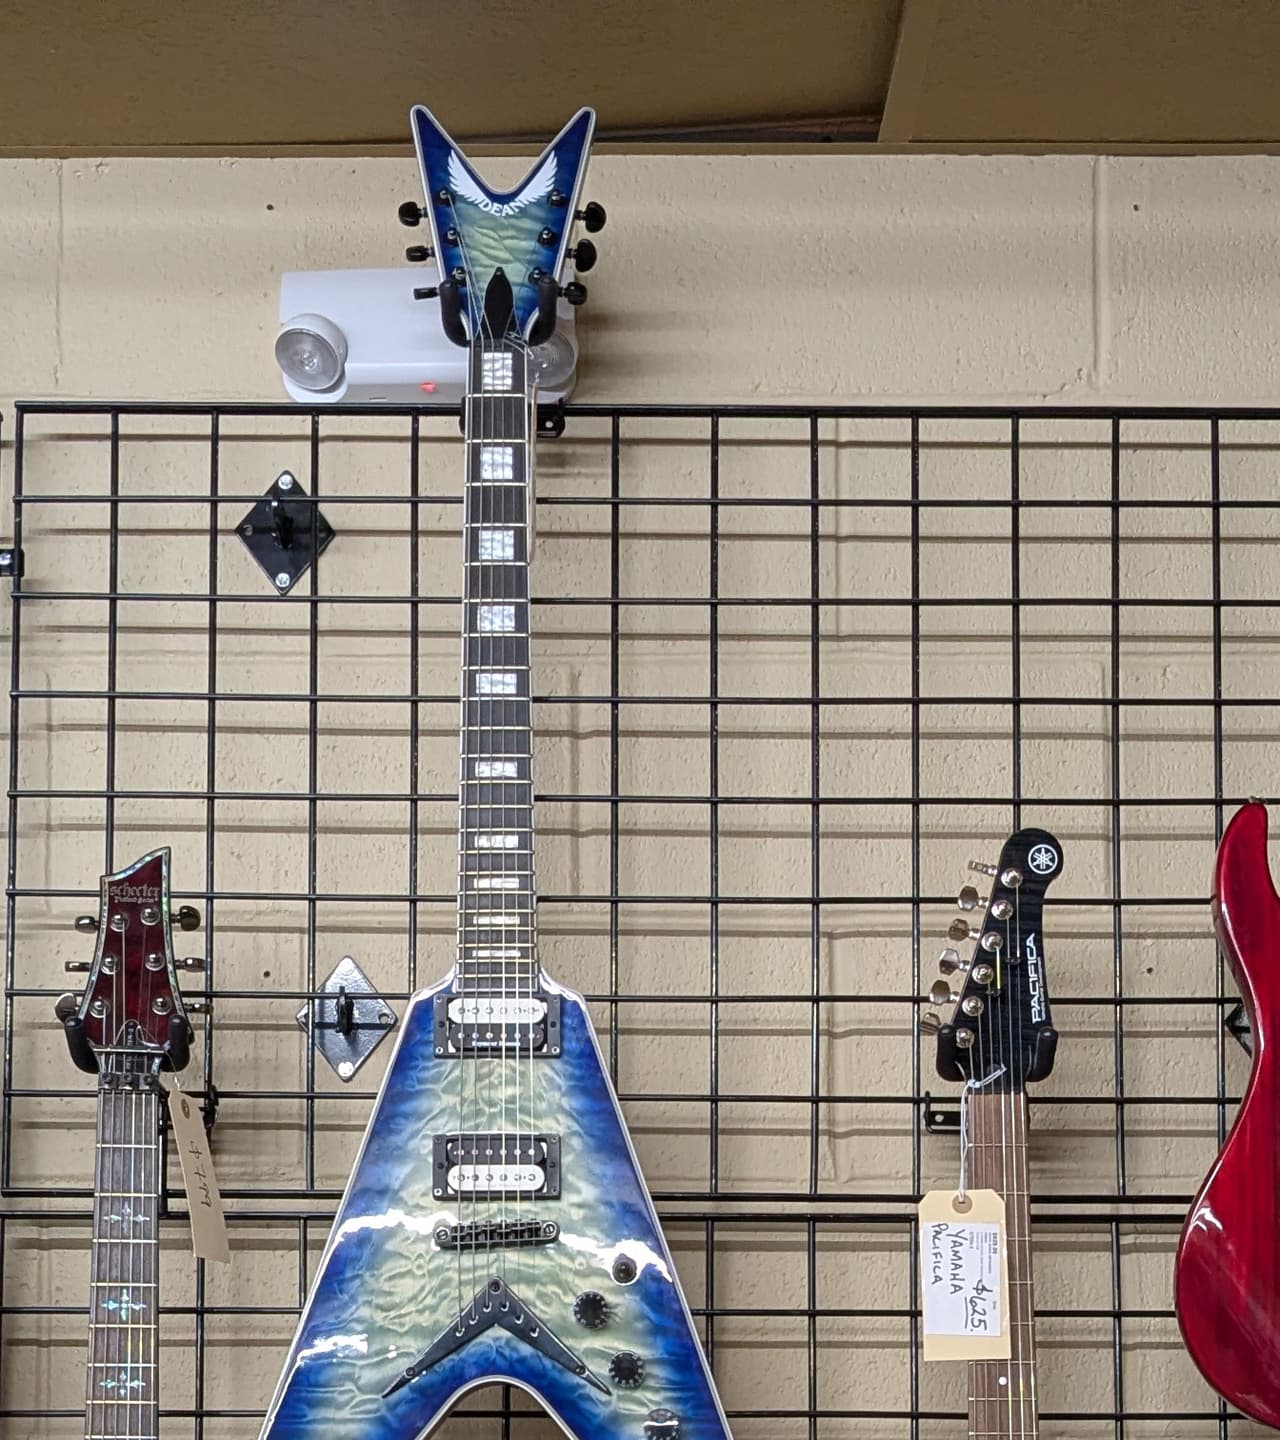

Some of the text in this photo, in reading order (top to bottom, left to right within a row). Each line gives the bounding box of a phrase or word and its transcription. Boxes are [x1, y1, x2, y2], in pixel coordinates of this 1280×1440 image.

[479, 199, 527, 217] DEAN
[1031, 932, 1040, 1025] PACIFICA
[931, 1223, 949, 1285] PACIFICA
[946, 1229, 969, 1295] YAMAHA
